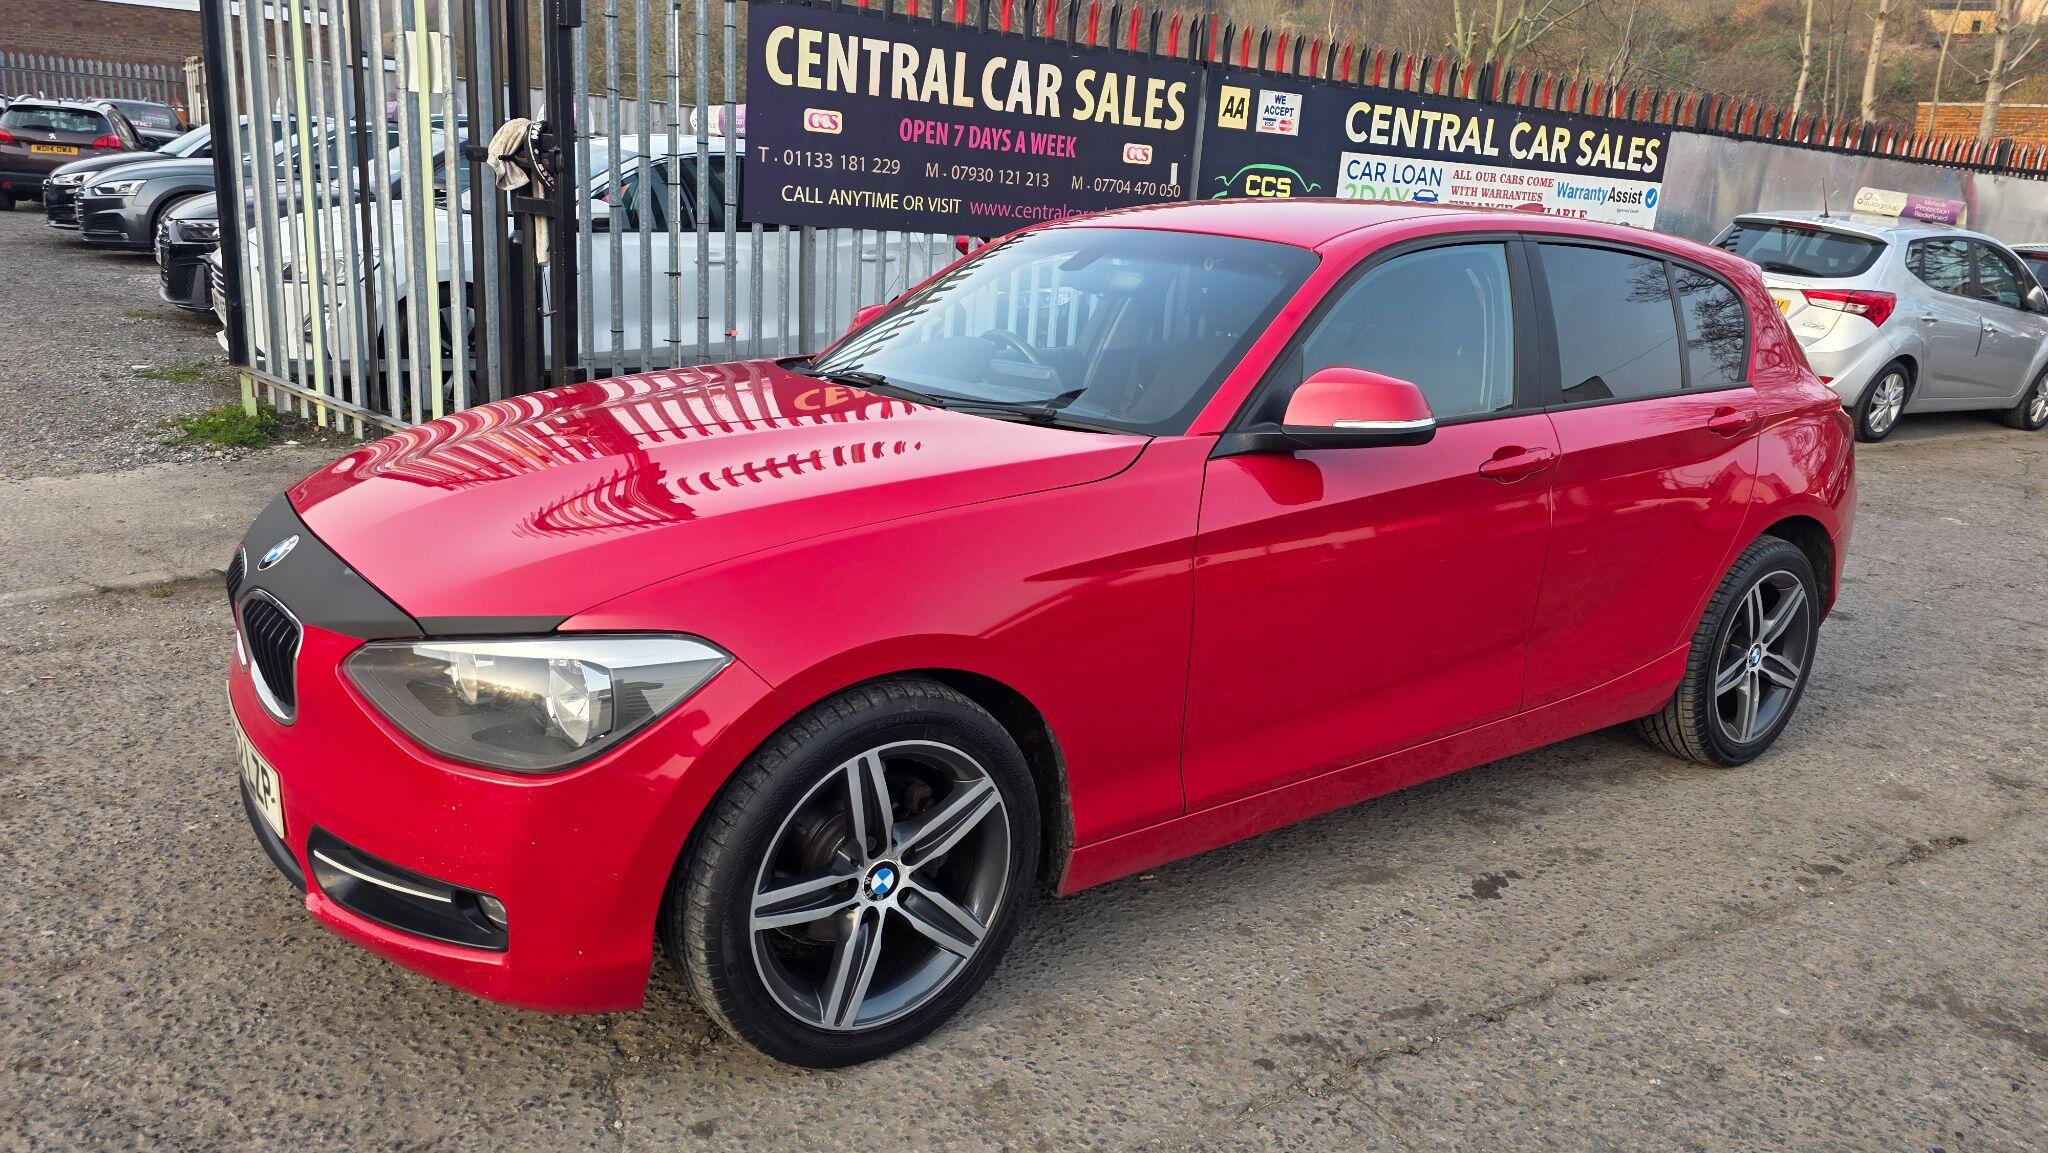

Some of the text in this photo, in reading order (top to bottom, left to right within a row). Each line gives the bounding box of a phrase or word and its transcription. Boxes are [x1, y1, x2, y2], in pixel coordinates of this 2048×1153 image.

[765, 25, 1187, 131] CENTRAL CAR SALES
[1222, 96, 1246, 119] AA
[1264, 105, 1294, 117] ACCEPT
[1274, 95, 1287, 105] WE
[900, 117, 1078, 158] OPEN 7 DAYS A WEEK
[1345, 101, 1661, 174] CENTRAL CAR SALES
[783, 149, 833, 169] 01133
[840, 154, 865, 172] 181
[871, 157, 901, 175] 229
[1346, 159, 1443, 187] CAR LOAN
[951, 165, 994, 182] 07930
[998, 169, 1021, 185] 121
[1026, 172, 1049, 187] 213
[1245, 175, 1292, 198] CCS
[1452, 169, 1555, 188] ALL OUR CARS COME
[1094, 177, 1131, 194] 07704
[1134, 182, 1156, 196] 470
[1159, 183, 1181, 198] 050
[1451, 185, 1544, 203] WITH WARRANTIES
[781, 185, 824, 204] CALL
[828, 189, 899, 210] ANYTIME
[903, 195, 923, 212] OR
[927, 197, 962, 214] VISIT
[1914, 204, 1950, 215] Protection
[1923, 199, 1948, 208] Vehicle
[1914, 210, 1949, 221] Redefined
